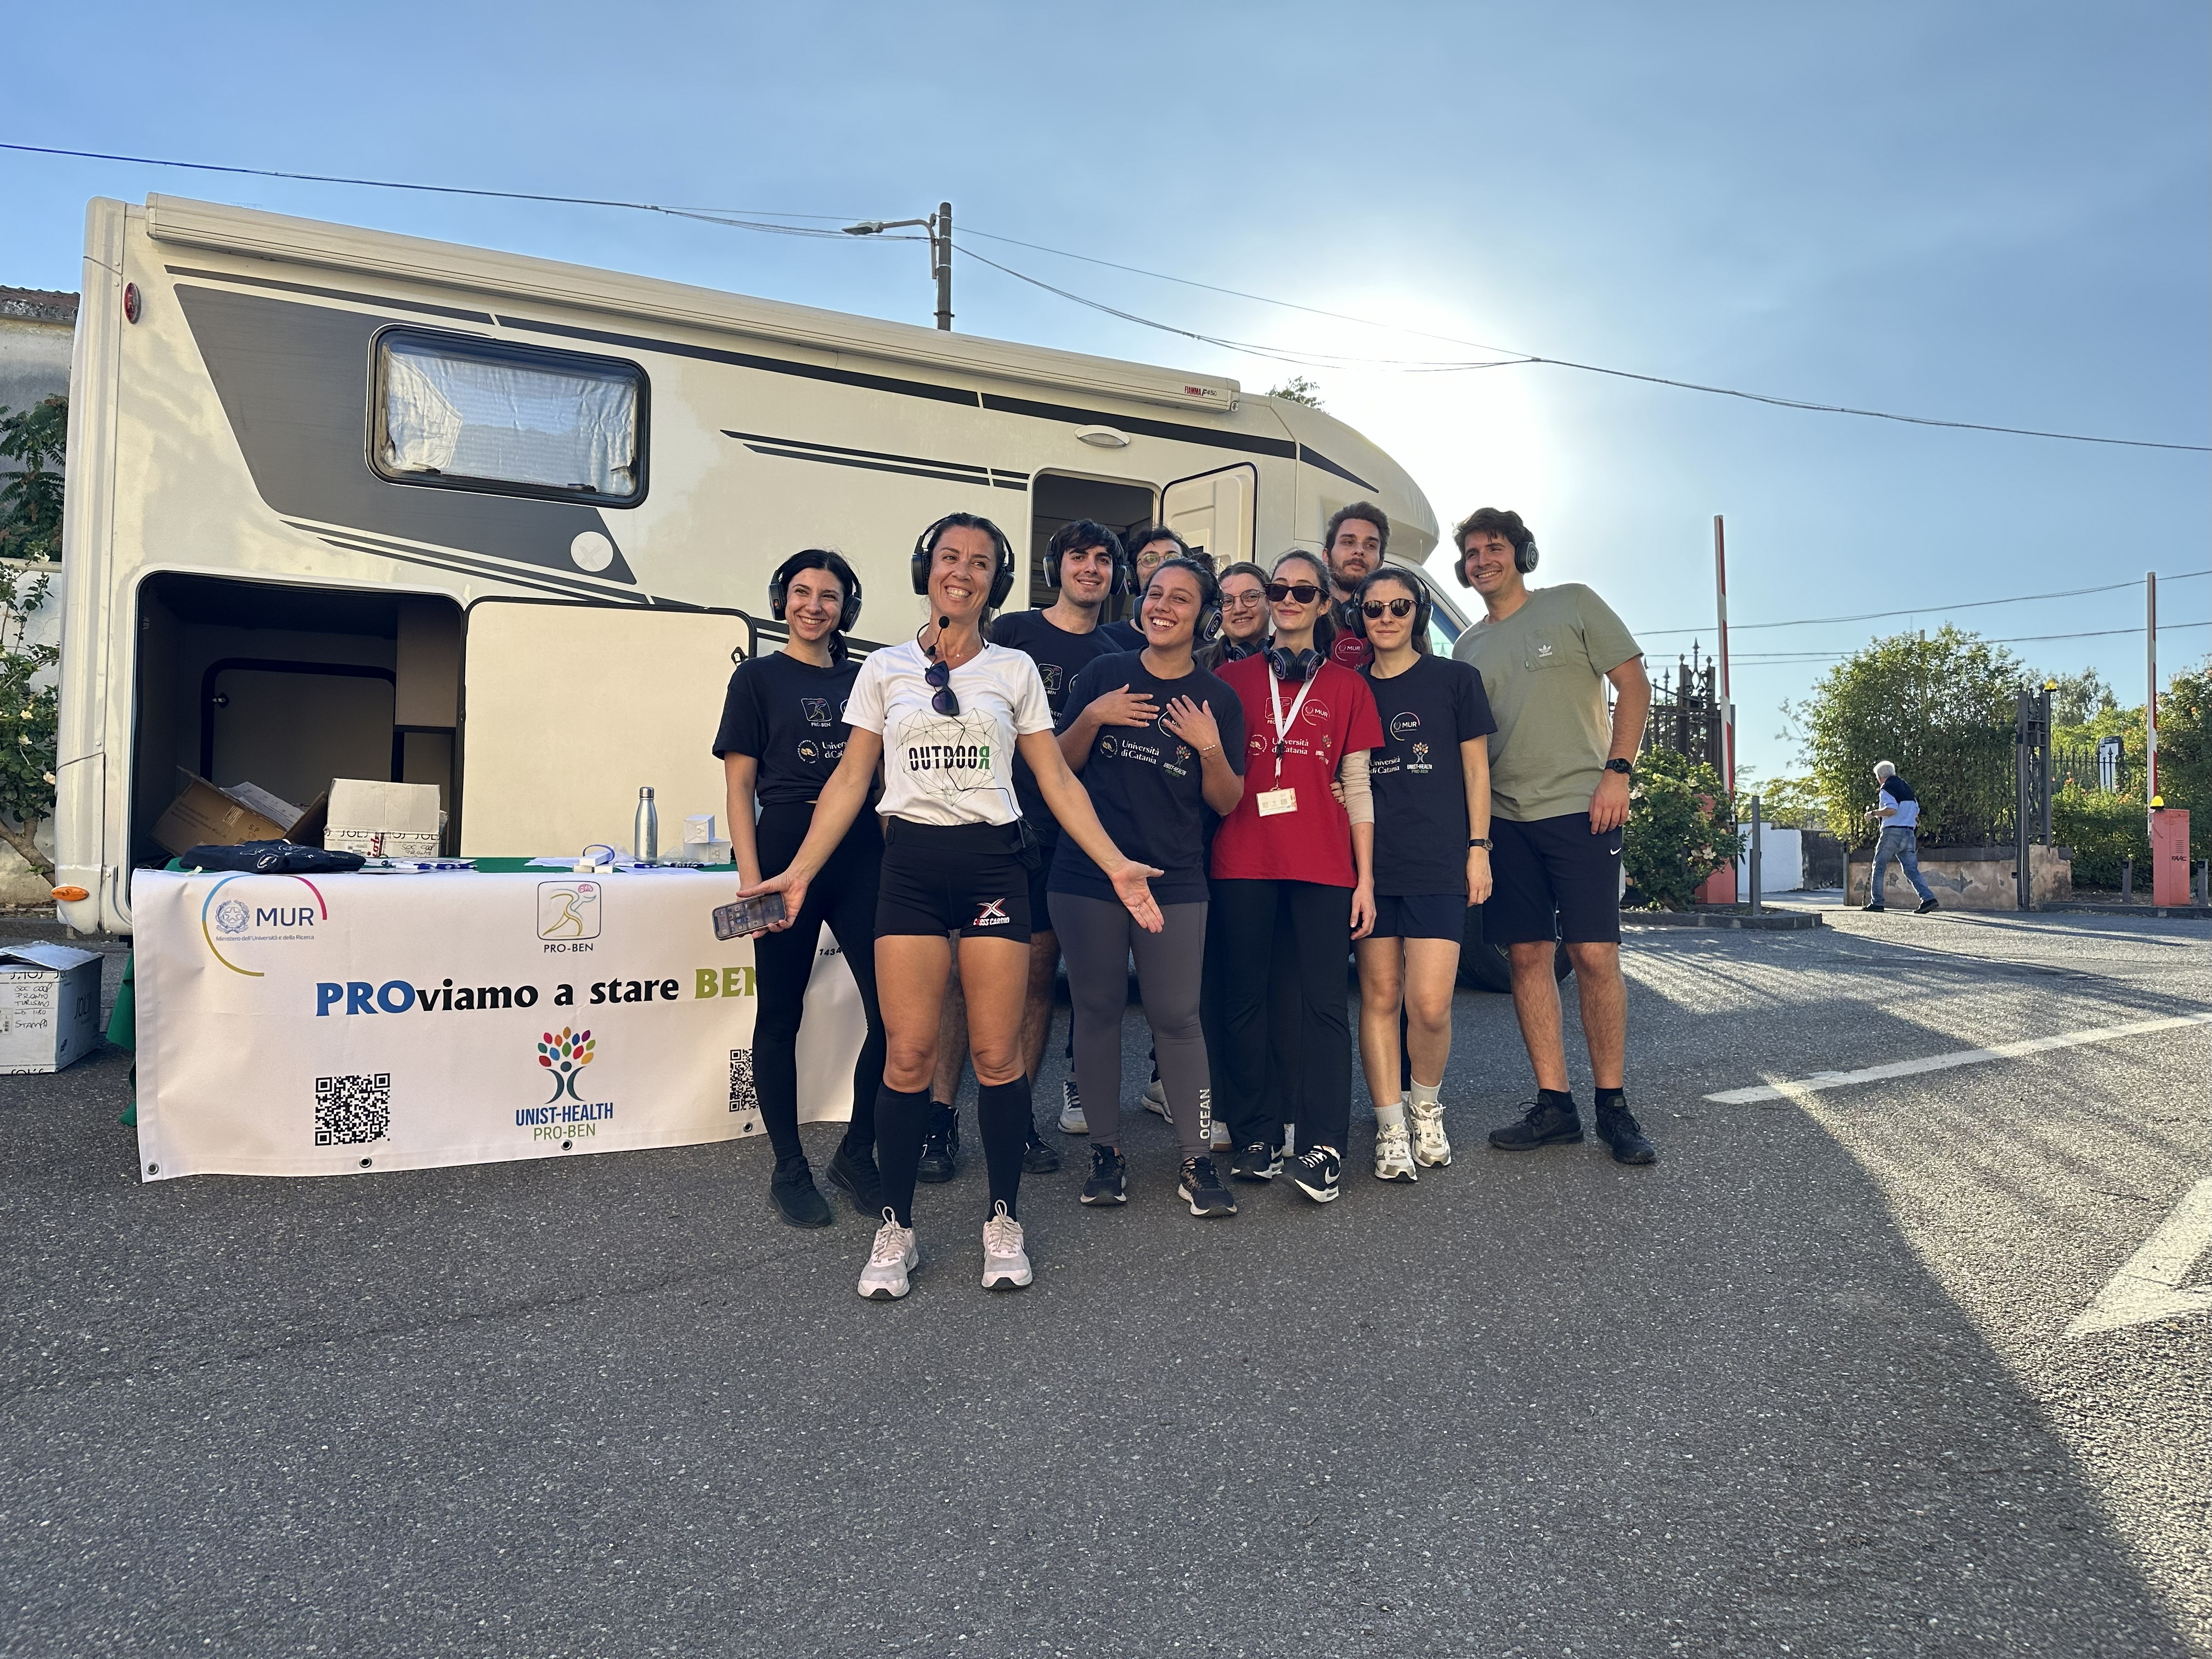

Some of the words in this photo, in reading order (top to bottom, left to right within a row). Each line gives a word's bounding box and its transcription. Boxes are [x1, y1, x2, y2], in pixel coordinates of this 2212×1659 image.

[1184, 386, 1201, 396] FIAMMA
[1314, 708, 1328, 718] MUR
[1122, 740, 1160, 756] Università
[1128, 750, 1156, 765] Catania
[1370, 755, 1401, 766] Università
[1377, 765, 1400, 774] Catania
[257, 907, 314, 927] MUR
[989, 917, 1010, 925] CARDIO
[544, 943, 594, 953] PRO-BEN
[316, 978, 539, 1017] PROviamo
[554, 984, 573, 1006] a
[590, 978, 679, 1005] stare
[15, 1019, 48, 1029] STAMPA
[516, 1102, 613, 1126] UNIST-HEALTH
[1199, 1088, 1210, 1139] OCEAN
[534, 1123, 595, 1141] PRO-BEN
